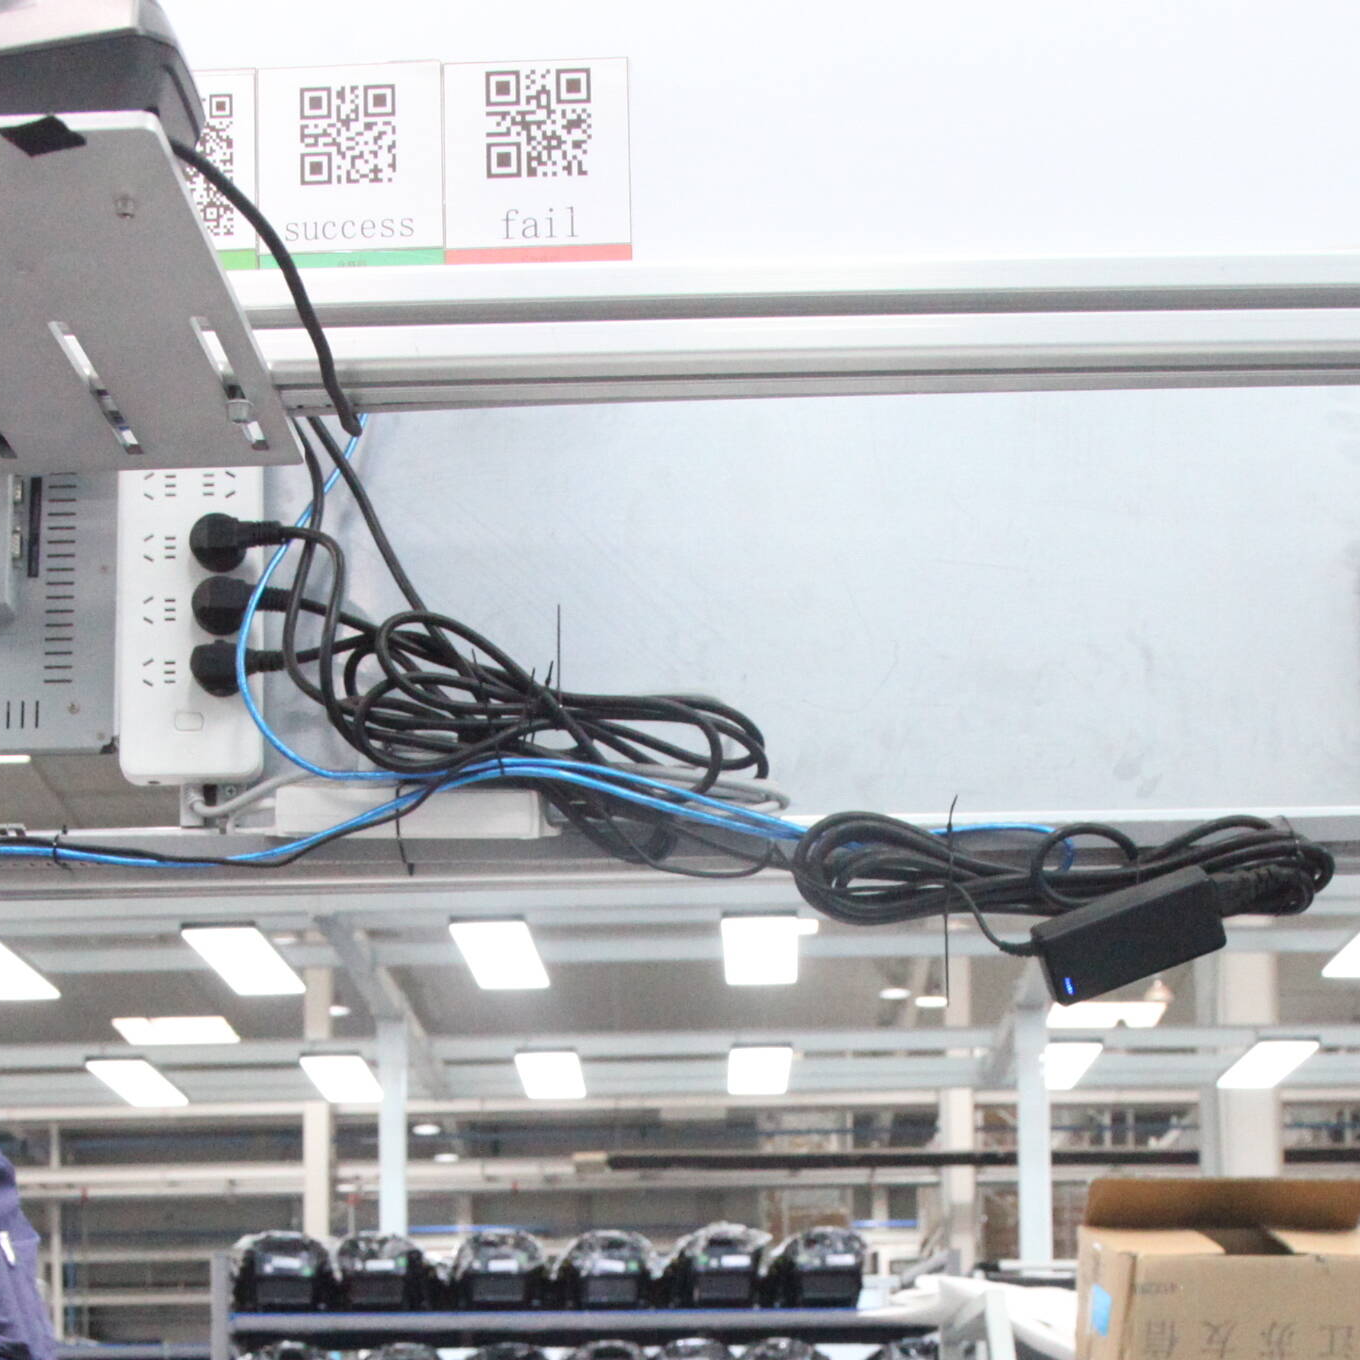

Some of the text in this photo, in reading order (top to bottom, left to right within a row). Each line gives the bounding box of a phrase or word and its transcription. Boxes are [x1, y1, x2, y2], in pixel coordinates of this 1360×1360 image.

[284, 215, 415, 242] success
[501, 206, 580, 240] fail
[1143, 1320, 1355, 1360] 江苏友信
